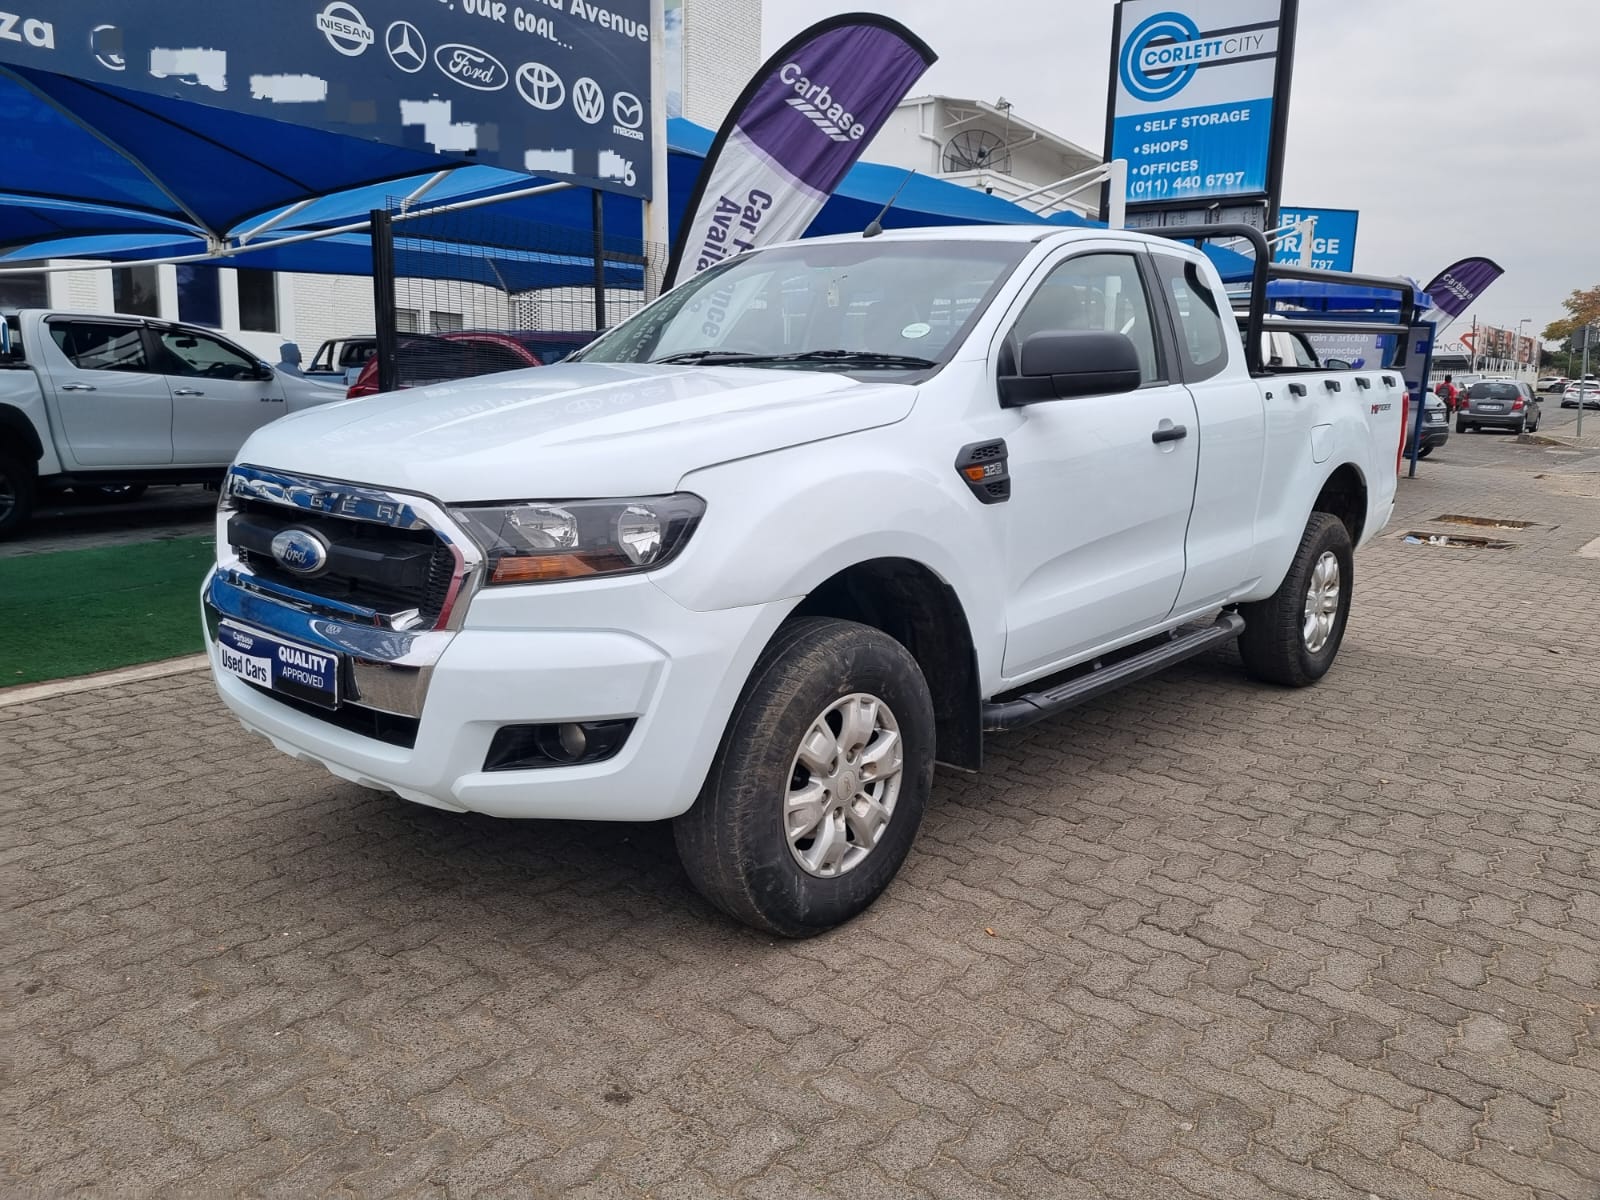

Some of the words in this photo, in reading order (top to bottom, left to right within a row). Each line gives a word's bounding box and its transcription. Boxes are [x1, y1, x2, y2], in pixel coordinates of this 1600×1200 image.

[0, 11, 55, 50] za
[320, 17, 371, 41] NISSAN
[570, 0, 649, 42] Avenue
[1144, 40, 1223, 66] CORLETT
[1224, 34, 1264, 54] CITY
[449, 50, 495, 84] Ford
[780, 62, 865, 140] Carbase
[1143, 118, 1177, 133] SELF
[1181, 109, 1250, 128] STORAGE
[1141, 139, 1188, 155] SHOPS
[1140, 159, 1198, 176] OFFICES
[1130, 179, 1168, 195] (011)
[1172, 175, 1200, 189] 440
[1206, 171, 1245, 187] 6797
[739, 189, 773, 235] Car
[1278, 213, 1319, 228] ELF
[1311, 259, 1334, 270] 797
[232, 476, 394, 520] RANGER
[222, 649, 243, 673] Used
[245, 657, 267, 682] Cars
[278, 646, 327, 673] QUALITY
[282, 666, 324, 688] APPROVED
